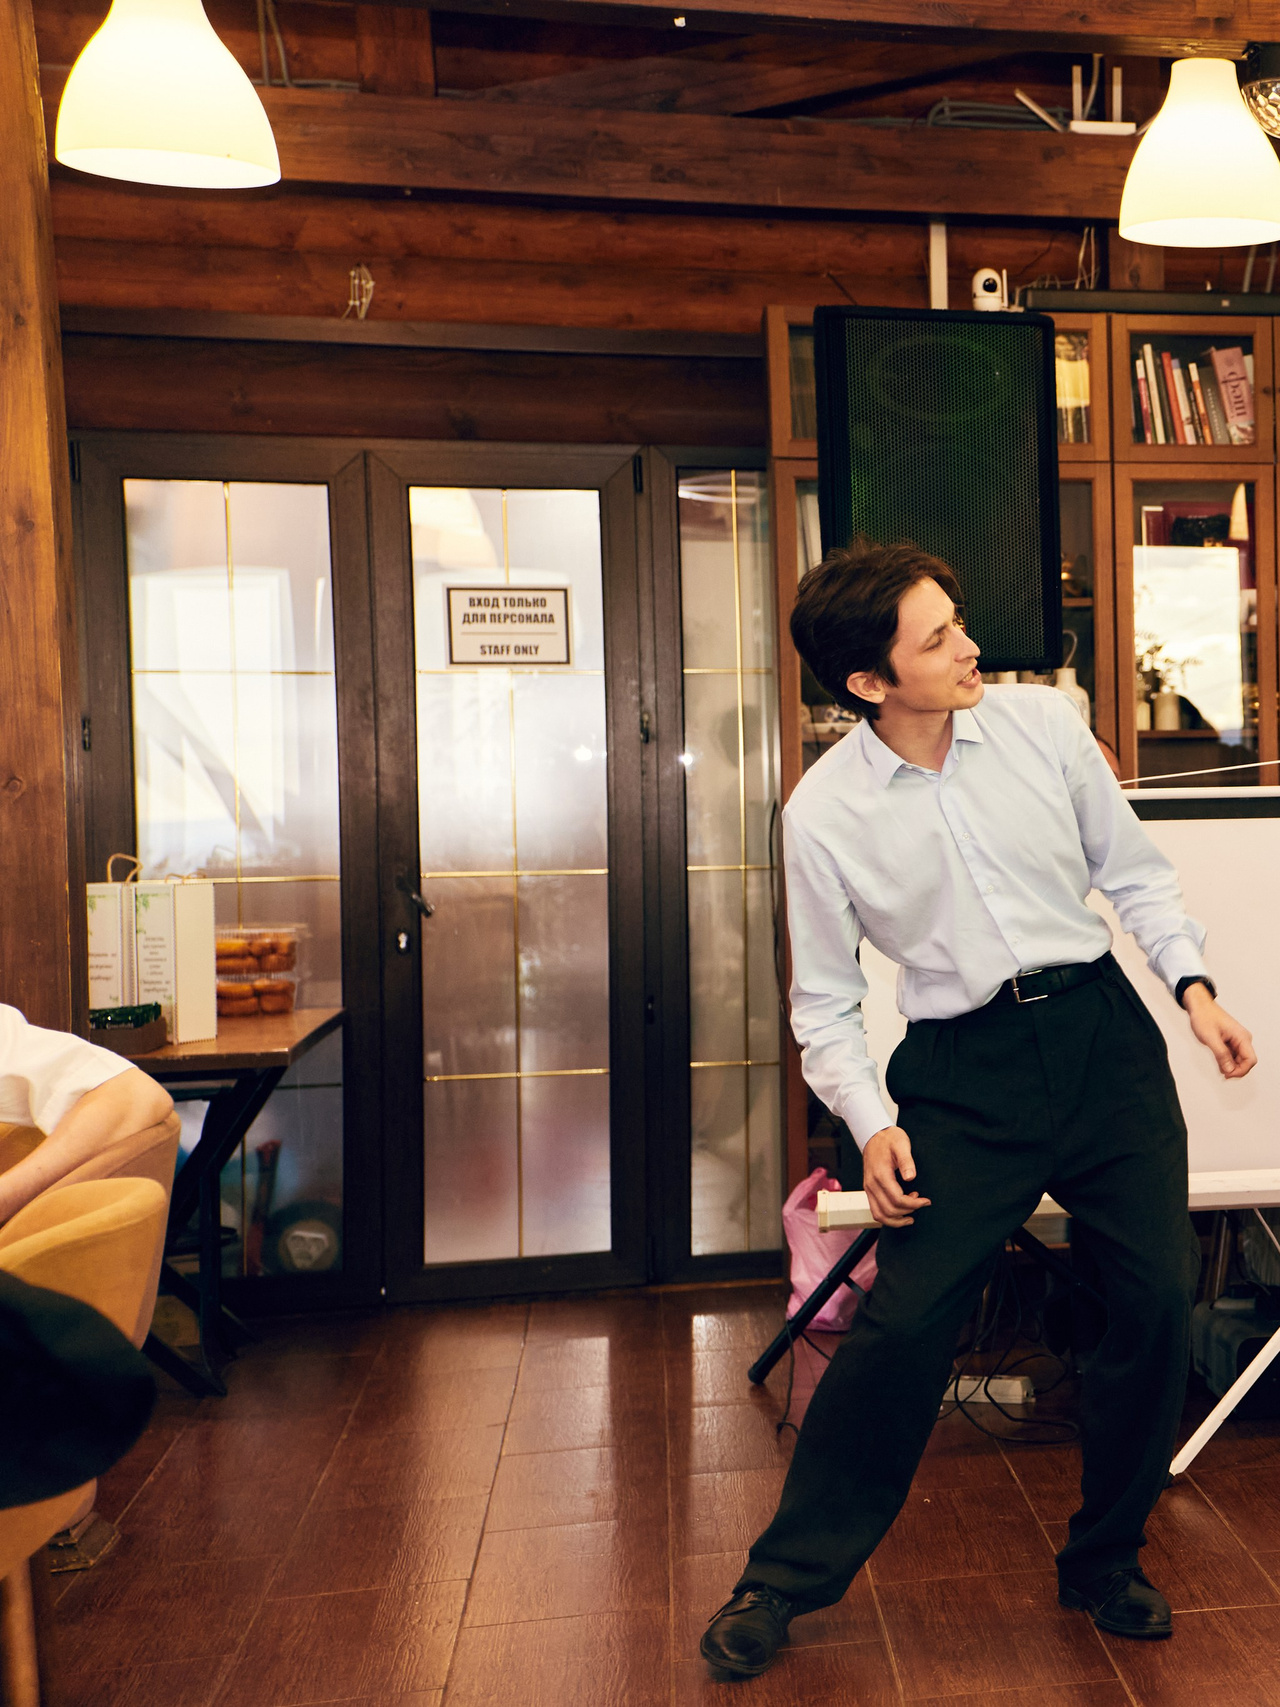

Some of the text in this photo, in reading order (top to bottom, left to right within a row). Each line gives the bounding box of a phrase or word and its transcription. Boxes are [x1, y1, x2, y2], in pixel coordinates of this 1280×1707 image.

[469, 597, 547, 609] ВХОД ТОЛЬКО
[462, 613, 555, 625] ДЛЯ ПЕРСОНАЛА
[480, 645, 540, 656] STAFF ONLY
